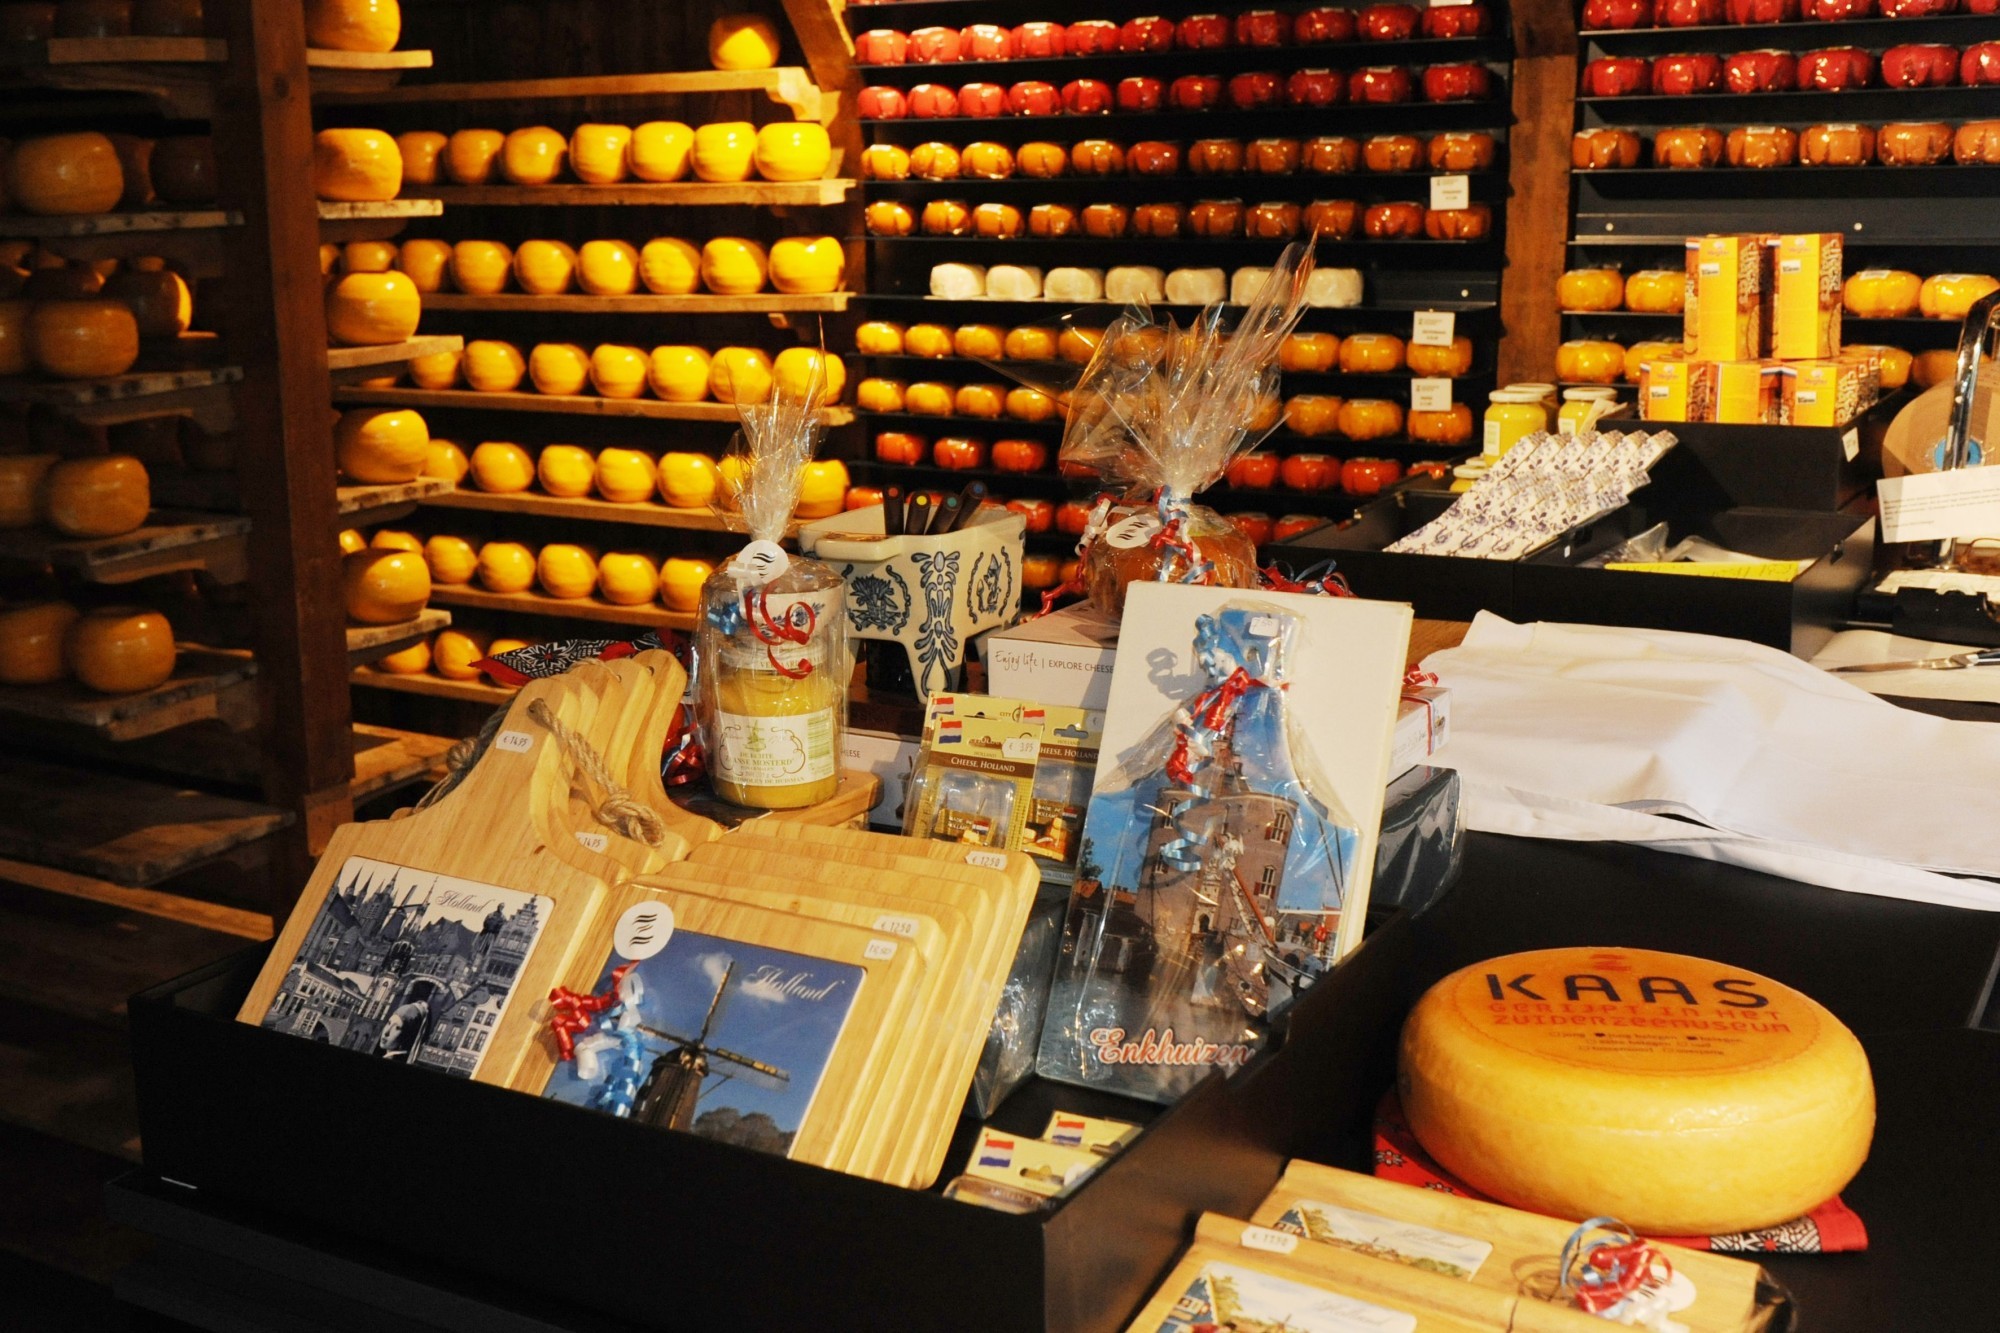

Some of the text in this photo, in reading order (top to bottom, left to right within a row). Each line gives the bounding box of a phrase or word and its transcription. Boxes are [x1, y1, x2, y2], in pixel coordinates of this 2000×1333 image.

[994, 650, 1114, 674] Enjoy life EXPLORE CHEESE
[980, 760, 1016, 773] HOLLAND
[436, 889, 496, 914] Holland
[742, 964, 846, 1001] Holland
[1485, 973, 1769, 1009] KAAS
[1090, 1027, 1256, 1066] Enkhuizen
